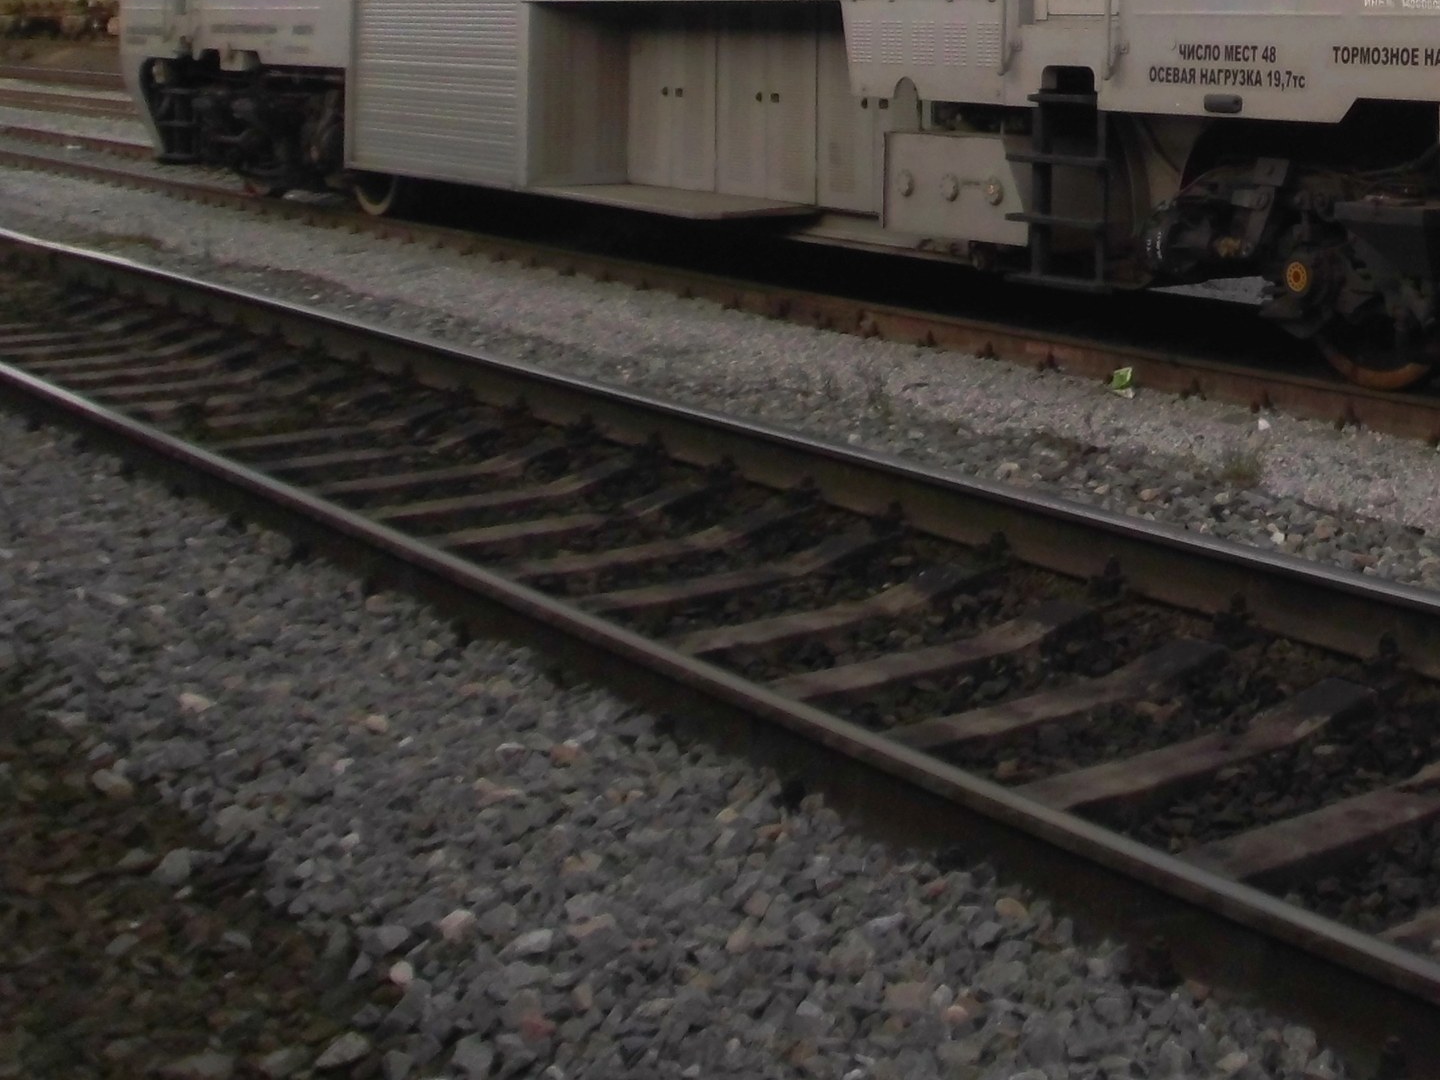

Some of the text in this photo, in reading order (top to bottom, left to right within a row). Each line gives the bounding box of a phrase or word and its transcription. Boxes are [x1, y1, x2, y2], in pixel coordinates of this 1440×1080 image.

[1179, 44, 1277, 63] ЧИСЛО МЕСТ 48
[1333, 46, 1419, 66] ТОРМОЗНОЕ
[1149, 66, 1306, 91] ОСЕВАЯ НАГРУЗКА 19,7тс
